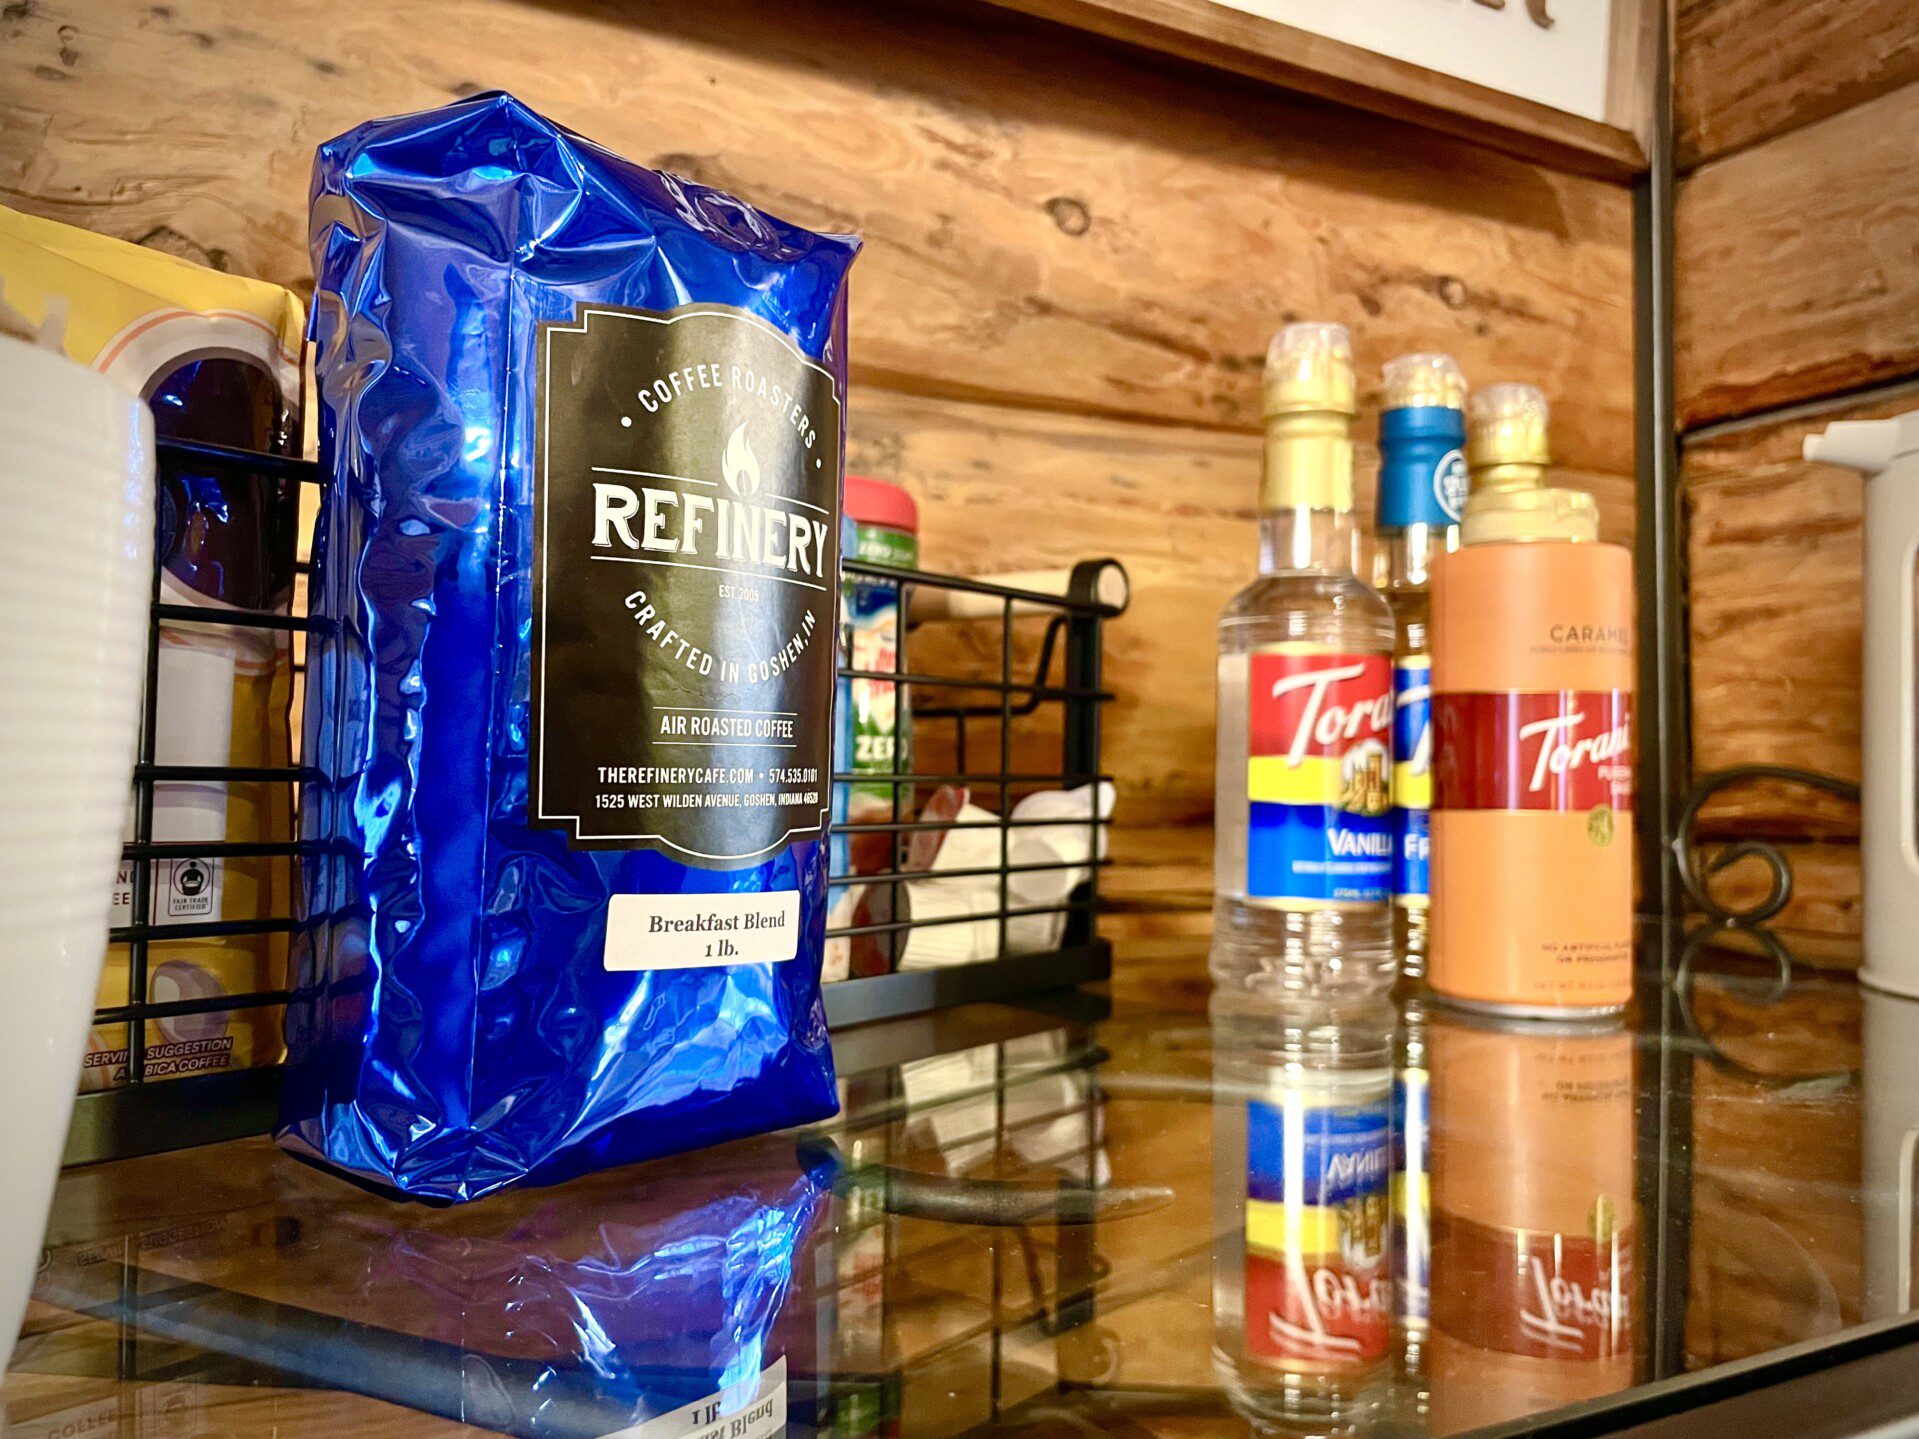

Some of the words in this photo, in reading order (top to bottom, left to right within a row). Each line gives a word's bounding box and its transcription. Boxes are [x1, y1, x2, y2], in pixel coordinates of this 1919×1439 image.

[637, 363, 723, 413] COFFEE
[731, 365, 816, 449] ROASTERS
[591, 483, 828, 578] REFINERY
[625, 590, 713, 677] CRAFTED
[720, 660, 739, 684] IN
[659, 715, 687, 735] AIR
[690, 716, 751, 737] ROASTED
[755, 719, 794, 738] COFFEE
[1271, 663, 1393, 769] Tora
[597, 766, 754, 784] THEREFINERYCAFE.COM
[769, 767, 818, 784] 574.535.0101
[595, 794, 625, 809] 1525
[628, 794, 660, 809] WEST
[662, 794, 702, 808] WILDEN
[704, 794, 742, 809] AVENUE,
[743, 792, 777, 808] GOSHEN,
[648, 913, 740, 934] Breakfast
[744, 910, 786, 930] Blend
[705, 944, 712, 958] 1
[717, 939, 739, 957] lb.
[147, 1038, 233, 1060] SUGGESTION
[115, 1062, 176, 1080] ABICA
[178, 1054, 229, 1072] COFFEE
